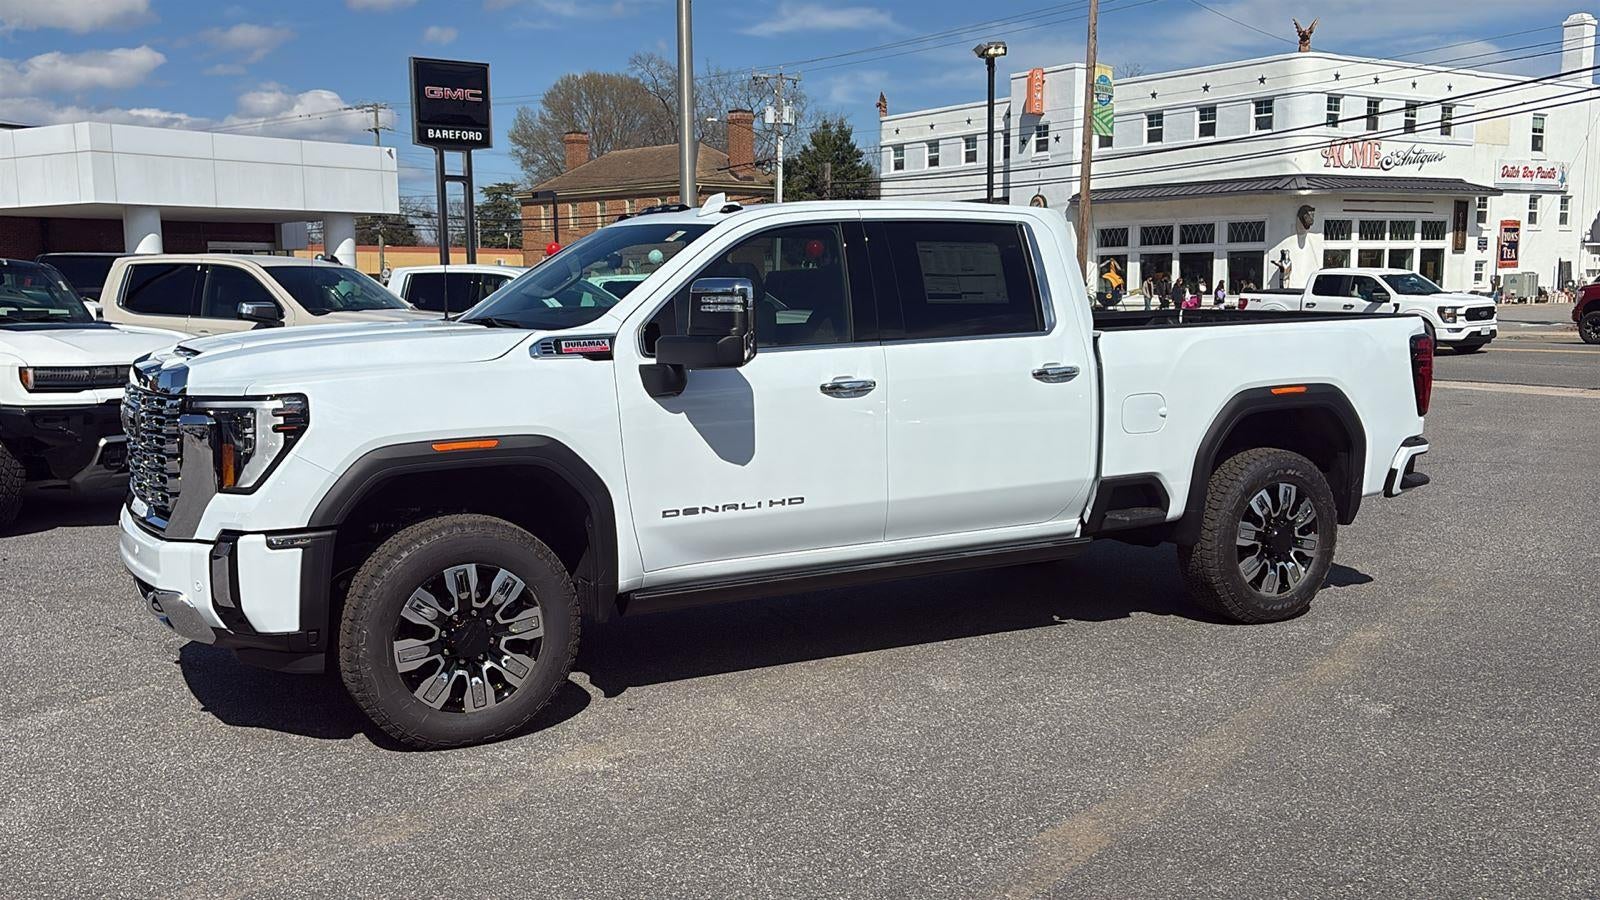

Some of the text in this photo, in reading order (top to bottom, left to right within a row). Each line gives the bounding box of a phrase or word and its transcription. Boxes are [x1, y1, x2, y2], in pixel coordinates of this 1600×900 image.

[425, 86, 482, 102] GMC
[1034, 71, 1042, 112] ACME
[427, 128, 482, 140] BAREFORD
[1321, 138, 1446, 171] ACME Antiques
[1501, 165, 1557, 181] Dutch Boy Paints
[1502, 247, 1516, 259] TEA
[564, 340, 607, 348] DURAMAX
[661, 496, 805, 518] DENALI HD
